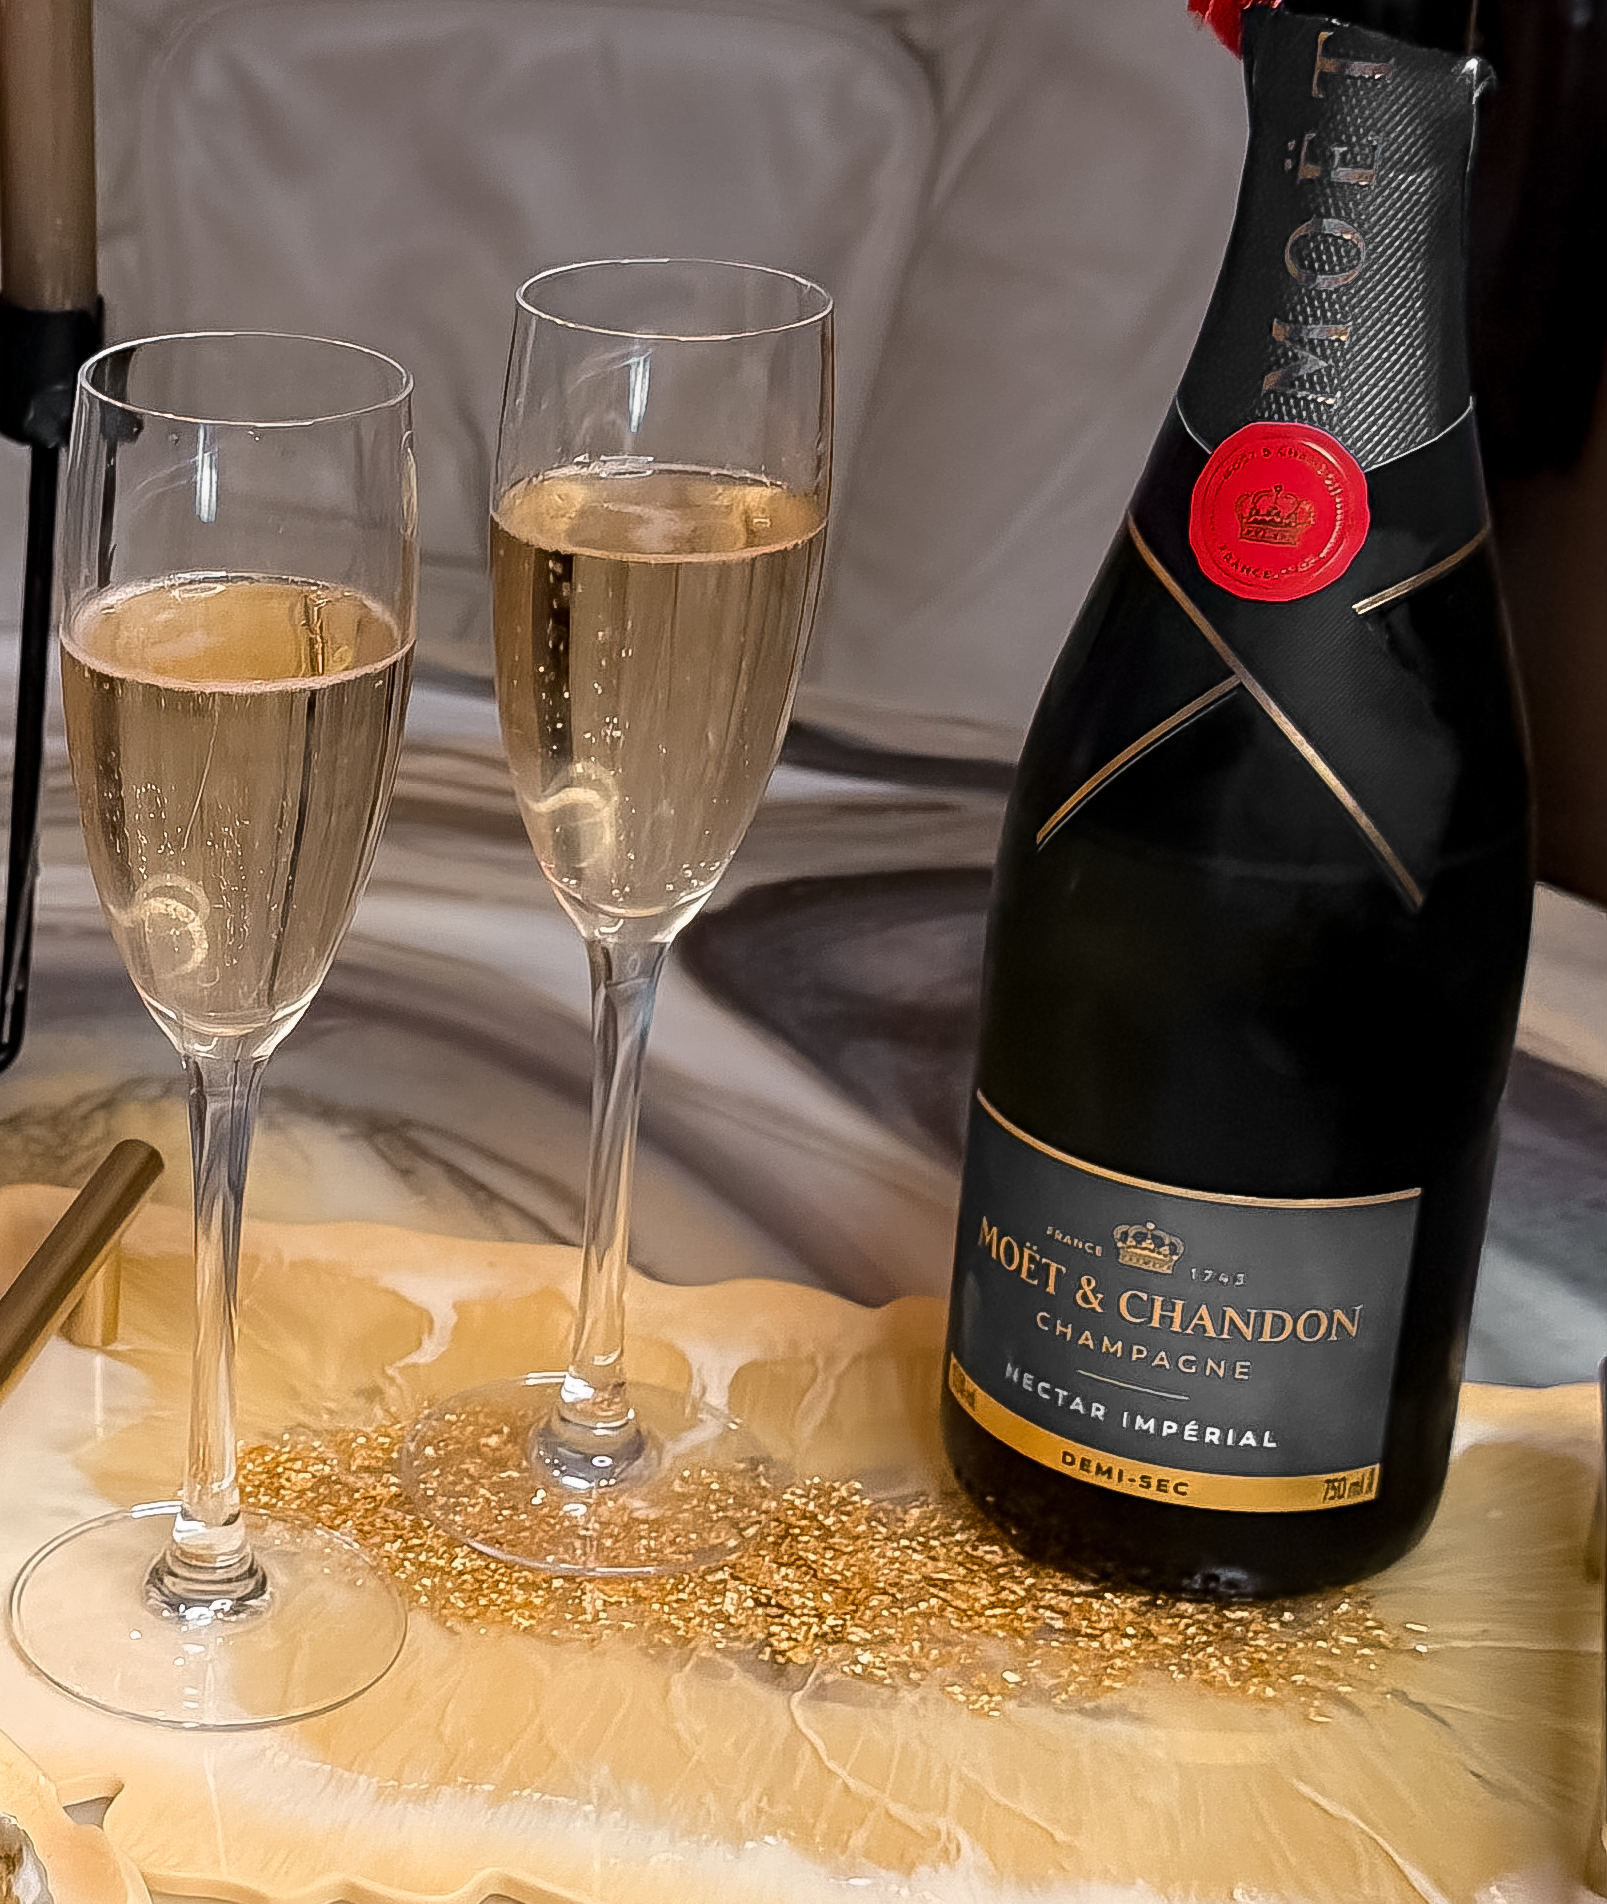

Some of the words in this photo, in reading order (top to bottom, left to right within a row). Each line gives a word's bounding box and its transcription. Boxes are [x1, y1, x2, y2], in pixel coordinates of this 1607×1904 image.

[1261, 30, 1393, 408] MOËT
[1046, 1225, 1103, 1257] FRANCE
[978, 1215, 1067, 1295] MOËT
[1075, 1275, 1104, 1312] &
[1119, 1290, 1364, 1343] CHANDON
[1190, 1267, 1246, 1287] 1743
[1036, 1311, 1253, 1381] CHAMPAGNE
[1005, 1361, 1106, 1422] NECTAR
[1122, 1411, 1278, 1448] IMPÉRIAL
[1061, 1450, 1190, 1497] DEMI-SEC
